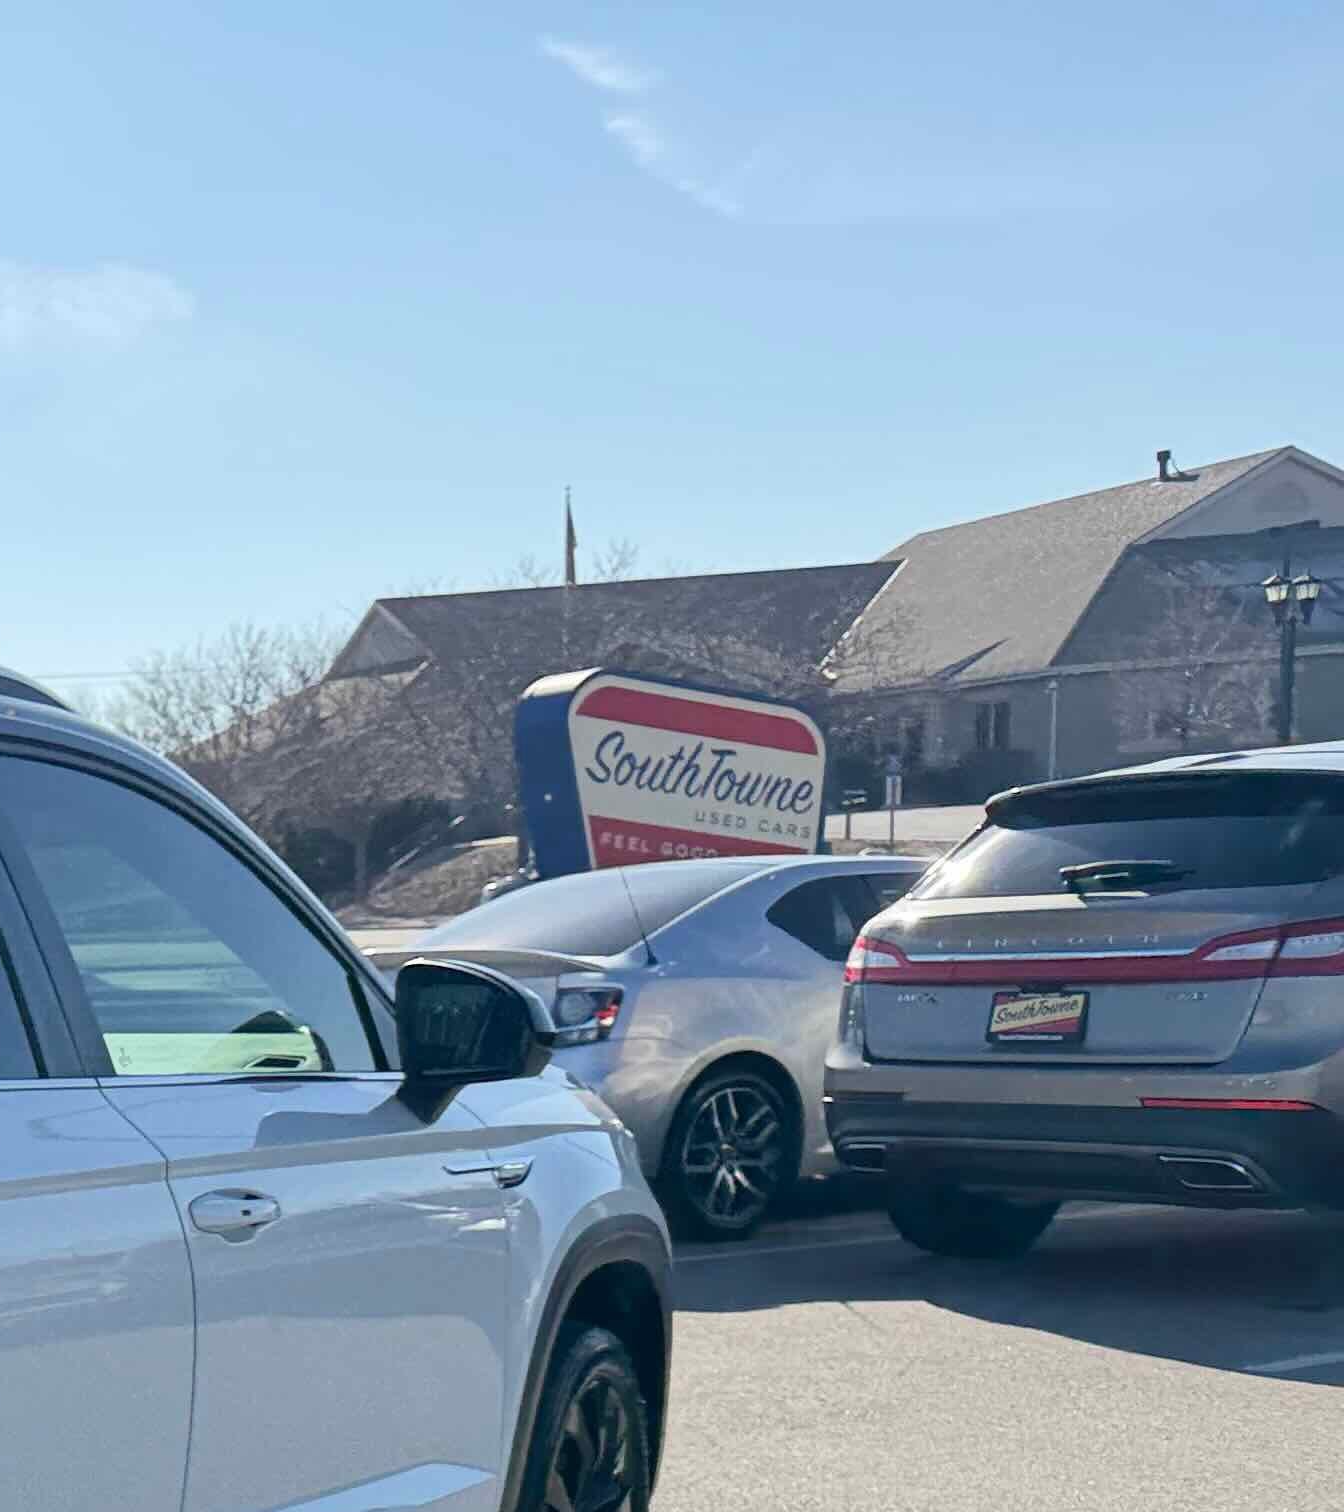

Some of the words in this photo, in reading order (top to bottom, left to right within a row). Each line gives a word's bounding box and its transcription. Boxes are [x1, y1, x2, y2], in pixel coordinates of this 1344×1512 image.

[585, 731, 814, 814] SouthTowne
[694, 809, 748, 832] USED
[757, 818, 811, 839] CARS
[599, 831, 650, 853] FEEL
[994, 999, 1079, 1024] SouthTowne
